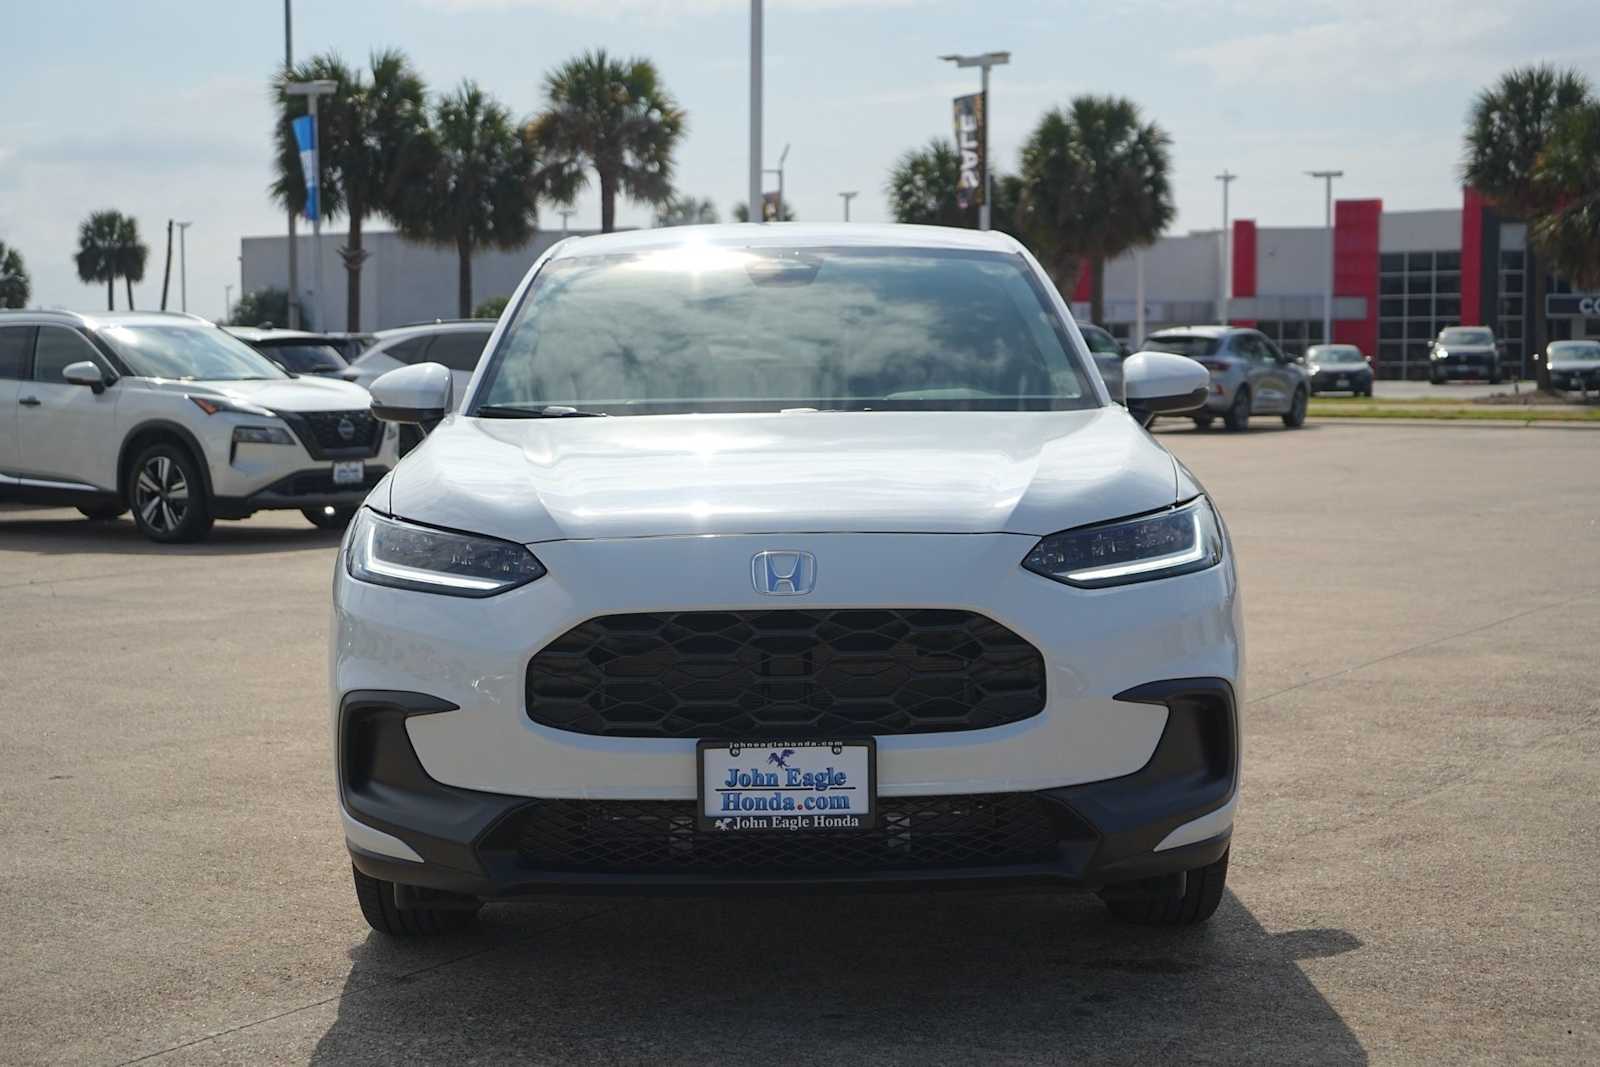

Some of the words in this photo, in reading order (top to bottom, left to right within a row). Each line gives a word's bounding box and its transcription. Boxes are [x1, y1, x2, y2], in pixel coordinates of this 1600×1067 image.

[725, 768, 779, 787] John
[785, 767, 847, 791] Eagle
[721, 792, 850, 811] Honda.com
[733, 817, 766, 830] John
[772, 817, 809, 831] Eagle
[814, 816, 859, 828] Honda
